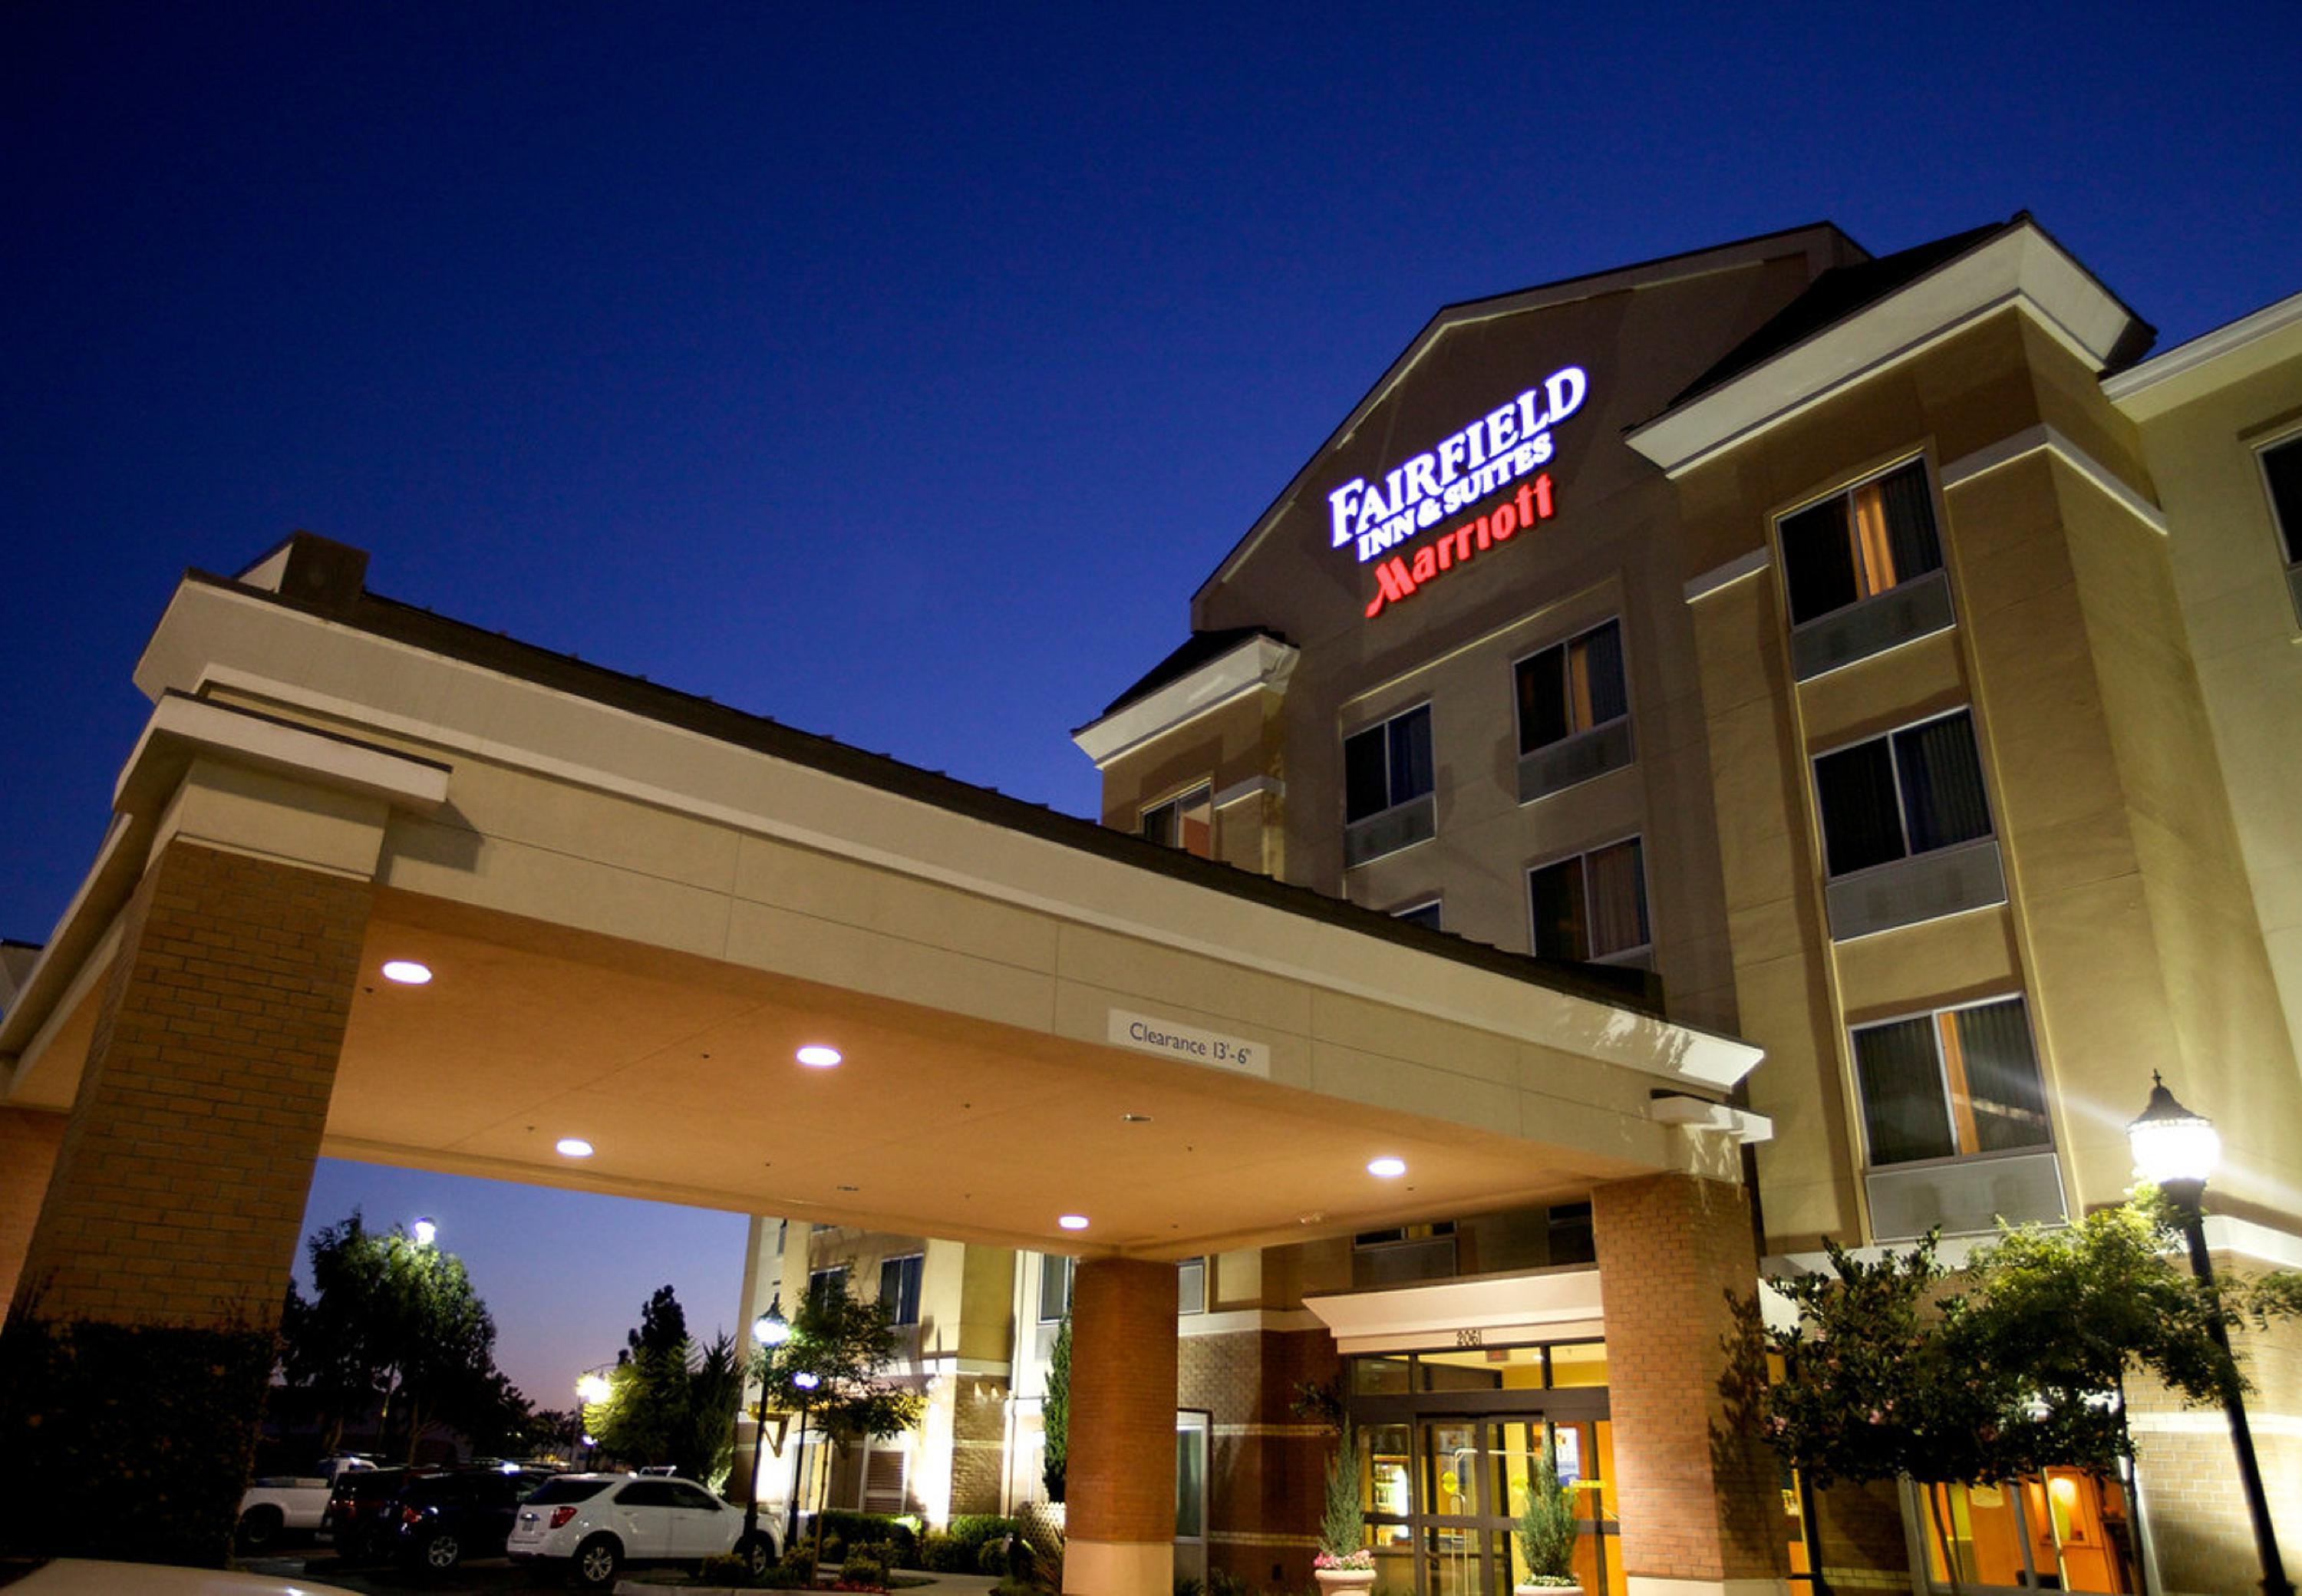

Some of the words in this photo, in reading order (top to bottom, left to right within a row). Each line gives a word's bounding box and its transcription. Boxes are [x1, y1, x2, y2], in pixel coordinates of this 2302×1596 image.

[1329, 366, 1587, 547] FAIRFIELD
[1357, 509, 1416, 562] INN
[1417, 499, 1443, 527] &
[1443, 432, 1554, 513] SUITES
[1364, 472, 1554, 618] Marriott
[1130, 1022, 1205, 1056] Clearance
